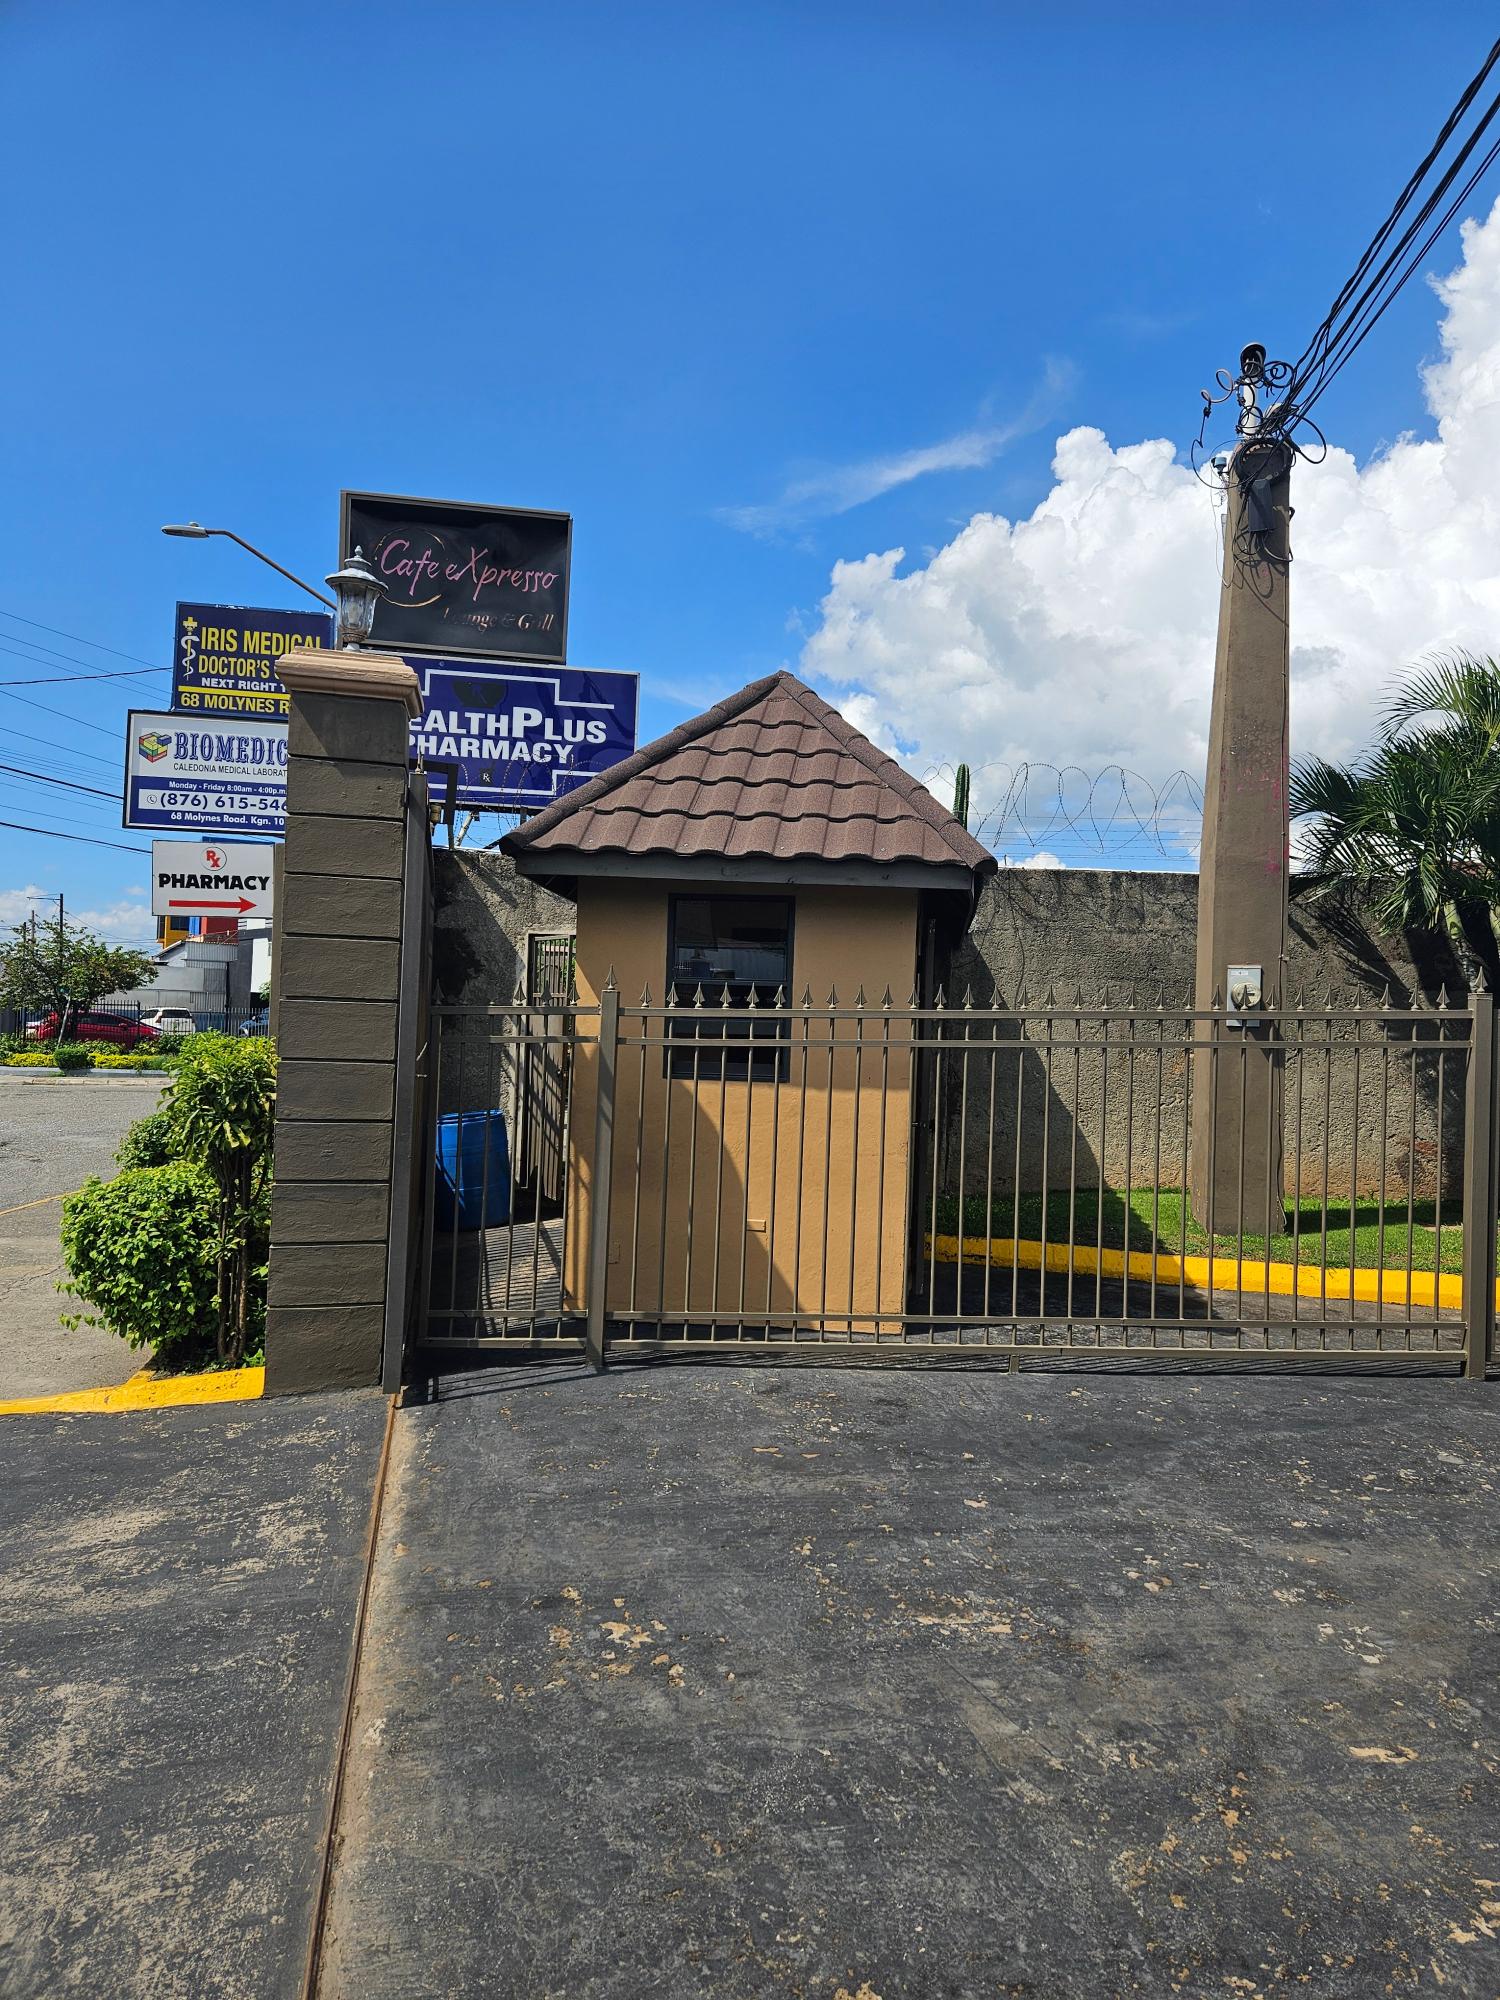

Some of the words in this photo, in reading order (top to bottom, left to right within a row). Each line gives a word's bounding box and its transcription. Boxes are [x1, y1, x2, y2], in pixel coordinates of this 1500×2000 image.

[380, 539, 439, 597] Cafe
[201, 626, 238, 652] IRIS
[198, 655, 270, 680] DOCTOR'S
[201, 677, 234, 689] NEXT
[238, 680, 277, 692] RIGHT
[181, 693, 200, 707] 68
[204, 695, 275, 713] MOLYNES
[173, 762, 217, 773] CALEDONIA
[218, 766, 250, 775] MEDICAL
[168, 781, 197, 790] Monday
[203, 782, 225, 792] Friday
[227, 784, 252, 793] 8:00am
[160, 793, 208, 810] (876)
[171, 812, 182, 820] 68
[184, 812, 221, 823] Molynes
[223, 814, 248, 824] Road.
[251, 815, 271, 826] Kgn.
[274, 817, 285, 826] 10
[158, 873, 271, 891] PHARMACY
